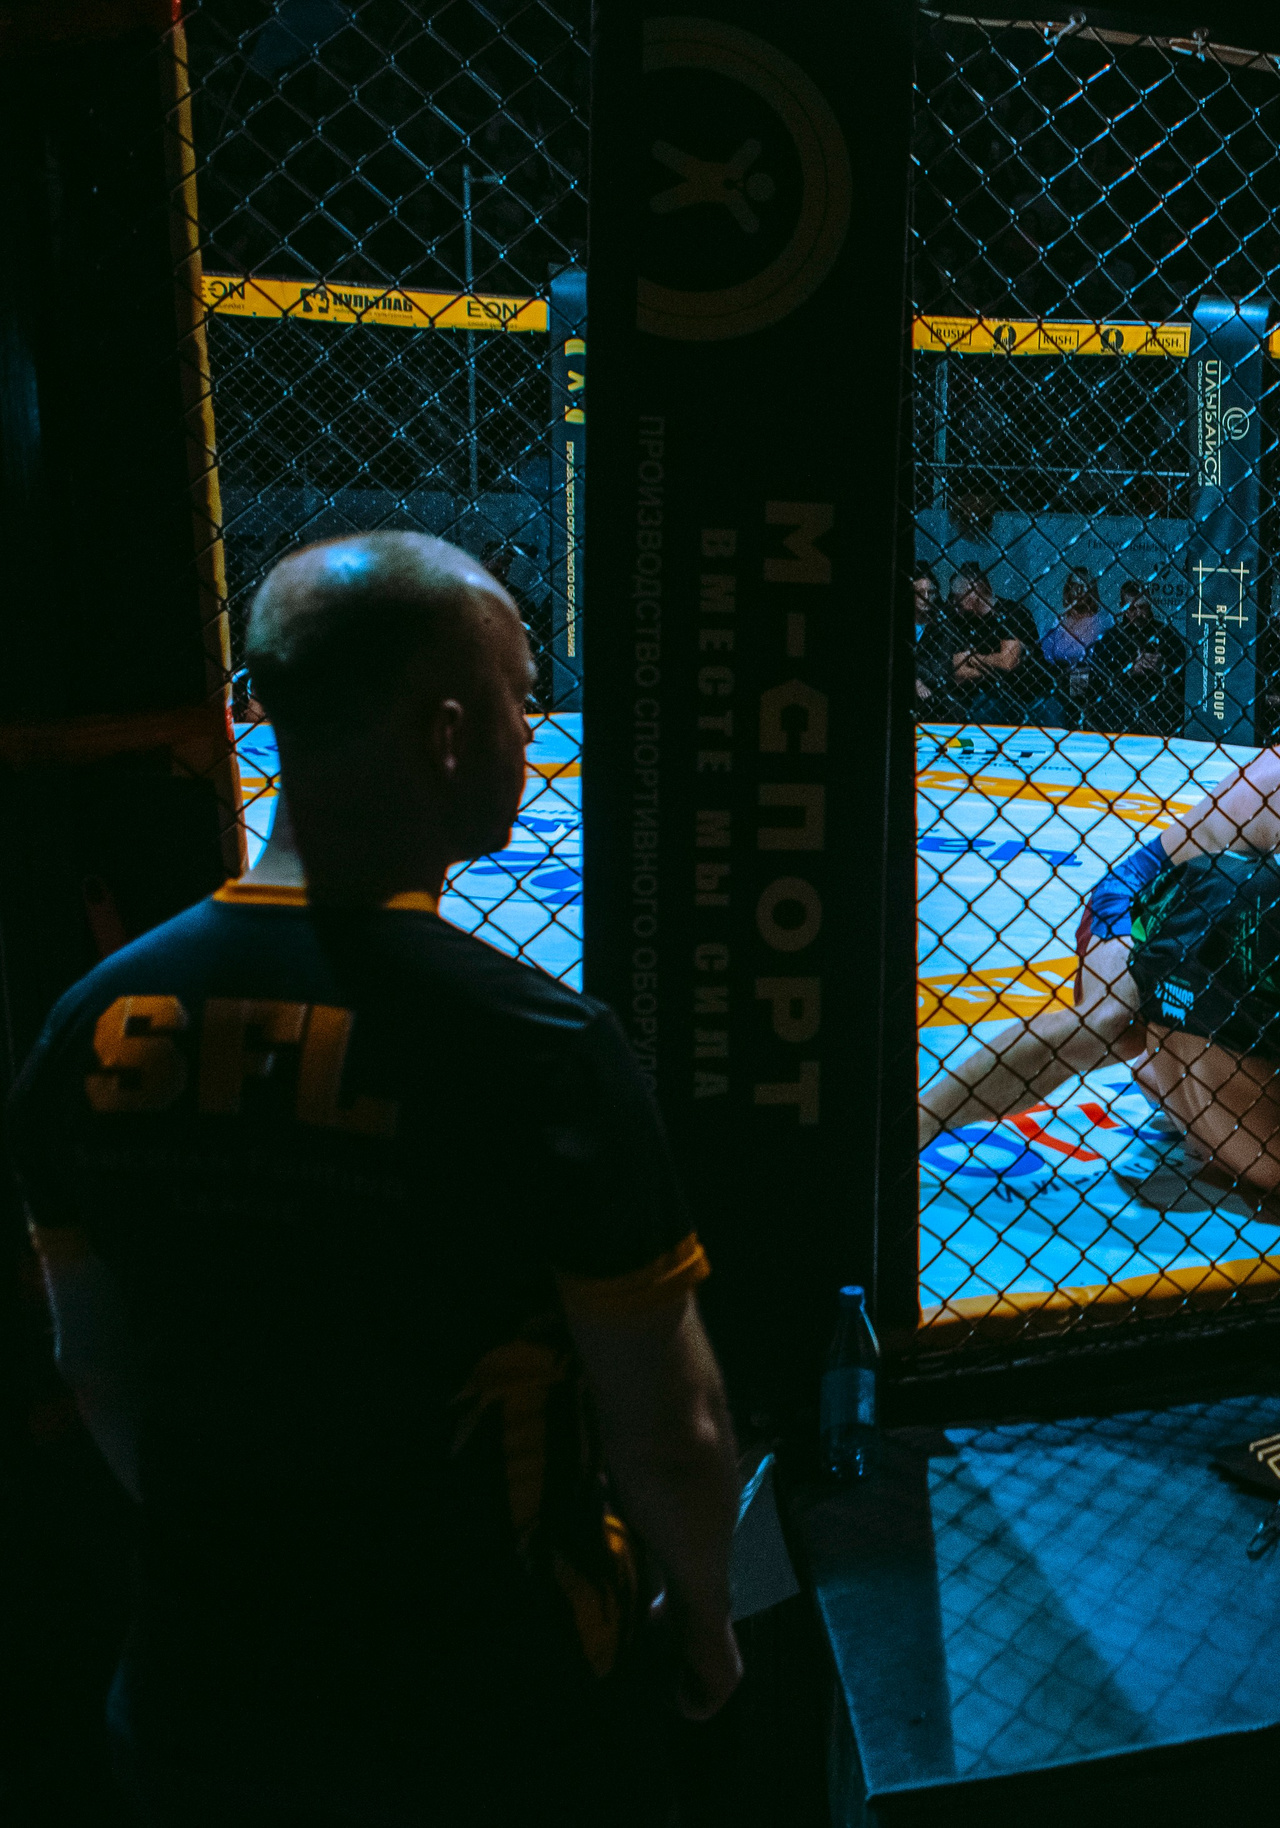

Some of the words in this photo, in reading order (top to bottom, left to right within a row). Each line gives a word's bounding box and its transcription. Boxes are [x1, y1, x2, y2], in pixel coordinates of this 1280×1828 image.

[1043, 332, 1075, 346] RUSH.
[631, 415, 666, 688] ПРОИЗВОДСТВО
[696, 528, 737, 773] ВМЕСТЕ
[631, 698, 661, 938] СПОРТИВНОГО
[694, 809, 732, 906] МЫ
[753, 500, 835, 1126] М-СПОРТ
[84, 994, 398, 1138] SFL
[631, 949, 660, 1094] ОБОРУД
[693, 941, 730, 1099] СИЛА
